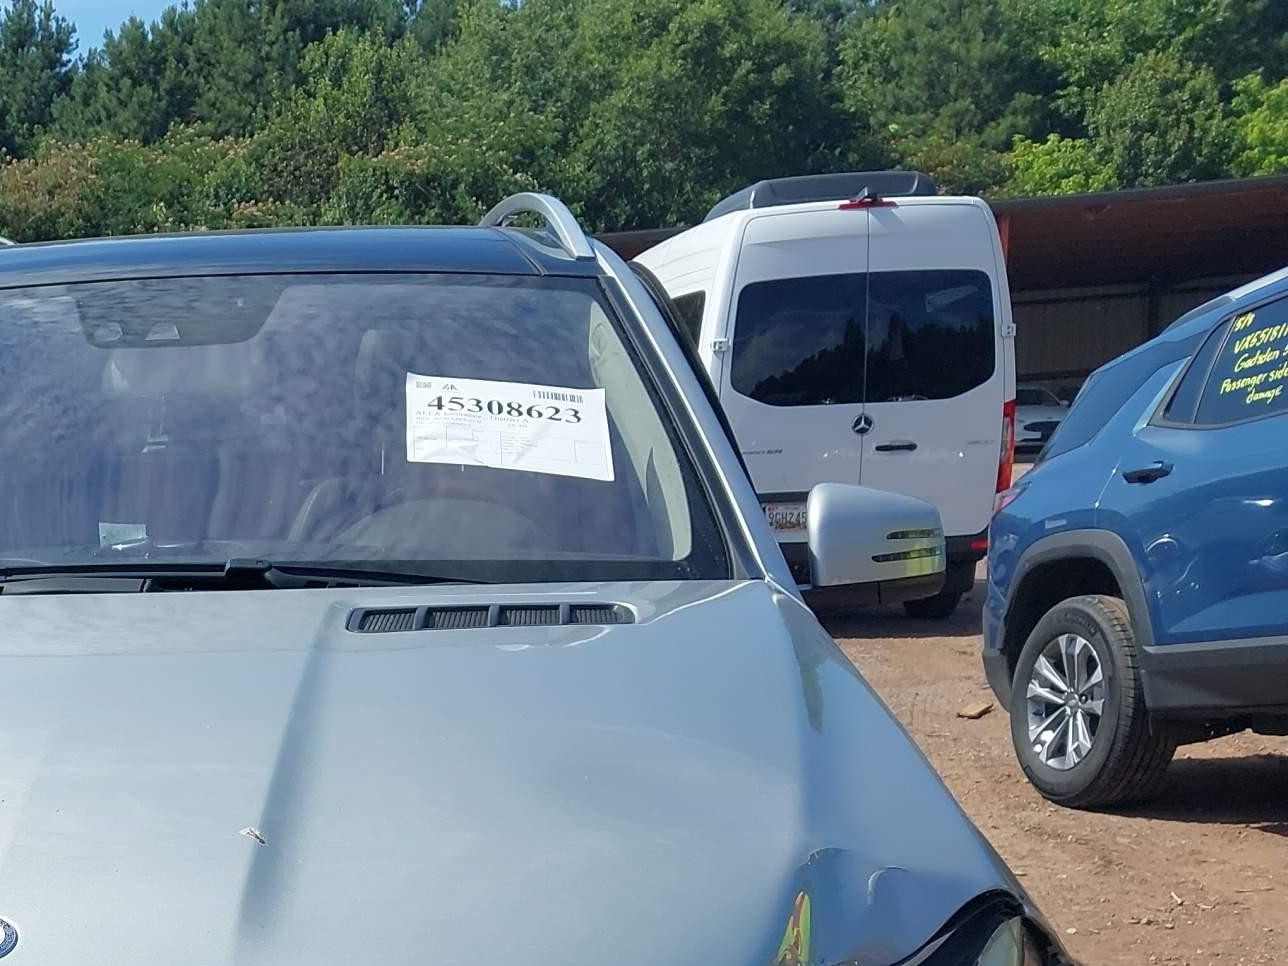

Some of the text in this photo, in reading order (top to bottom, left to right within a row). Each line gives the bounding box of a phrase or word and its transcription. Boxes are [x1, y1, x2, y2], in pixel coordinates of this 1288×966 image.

[1220, 372, 1268, 394] Passenger
[1246, 384, 1284, 404] damage
[427, 395, 582, 424] 45308623
